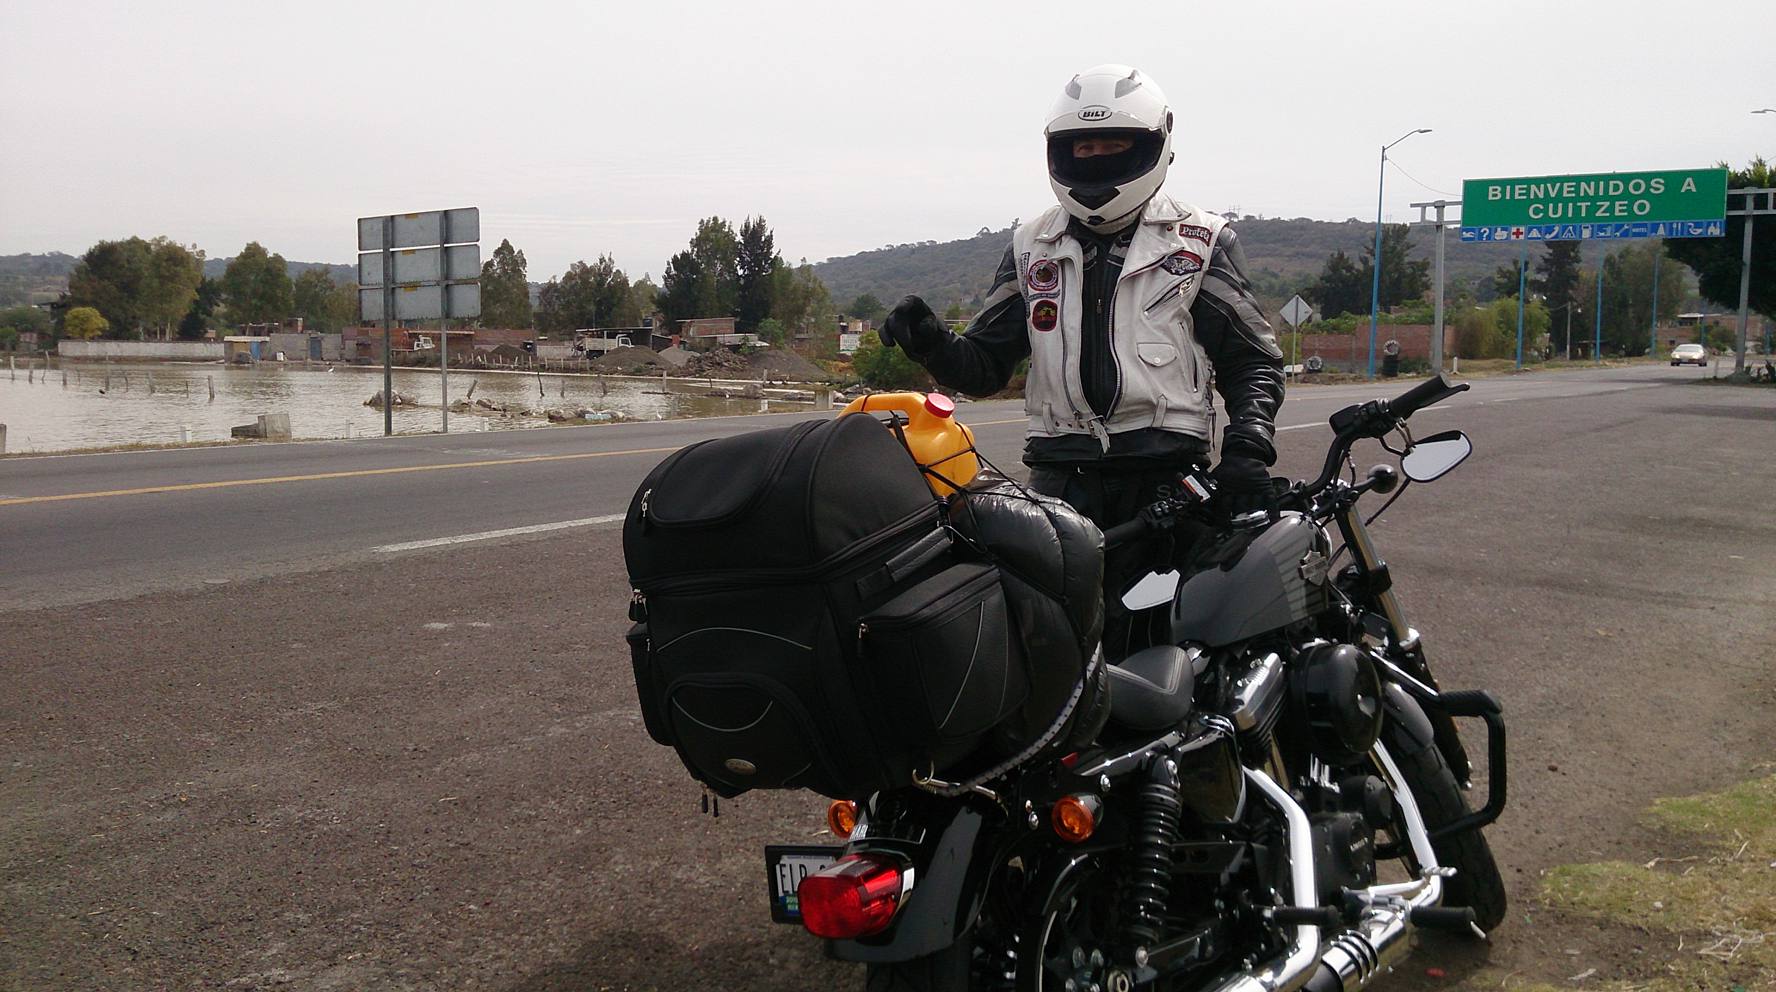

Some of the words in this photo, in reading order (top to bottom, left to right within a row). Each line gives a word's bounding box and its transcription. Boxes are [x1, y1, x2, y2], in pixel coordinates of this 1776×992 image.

[1082, 110, 1106, 118] BILT
[1487, 177, 1666, 201] BIENVENIDOS
[1680, 176, 1697, 193] A
[1528, 199, 1651, 219] CUITZEO
